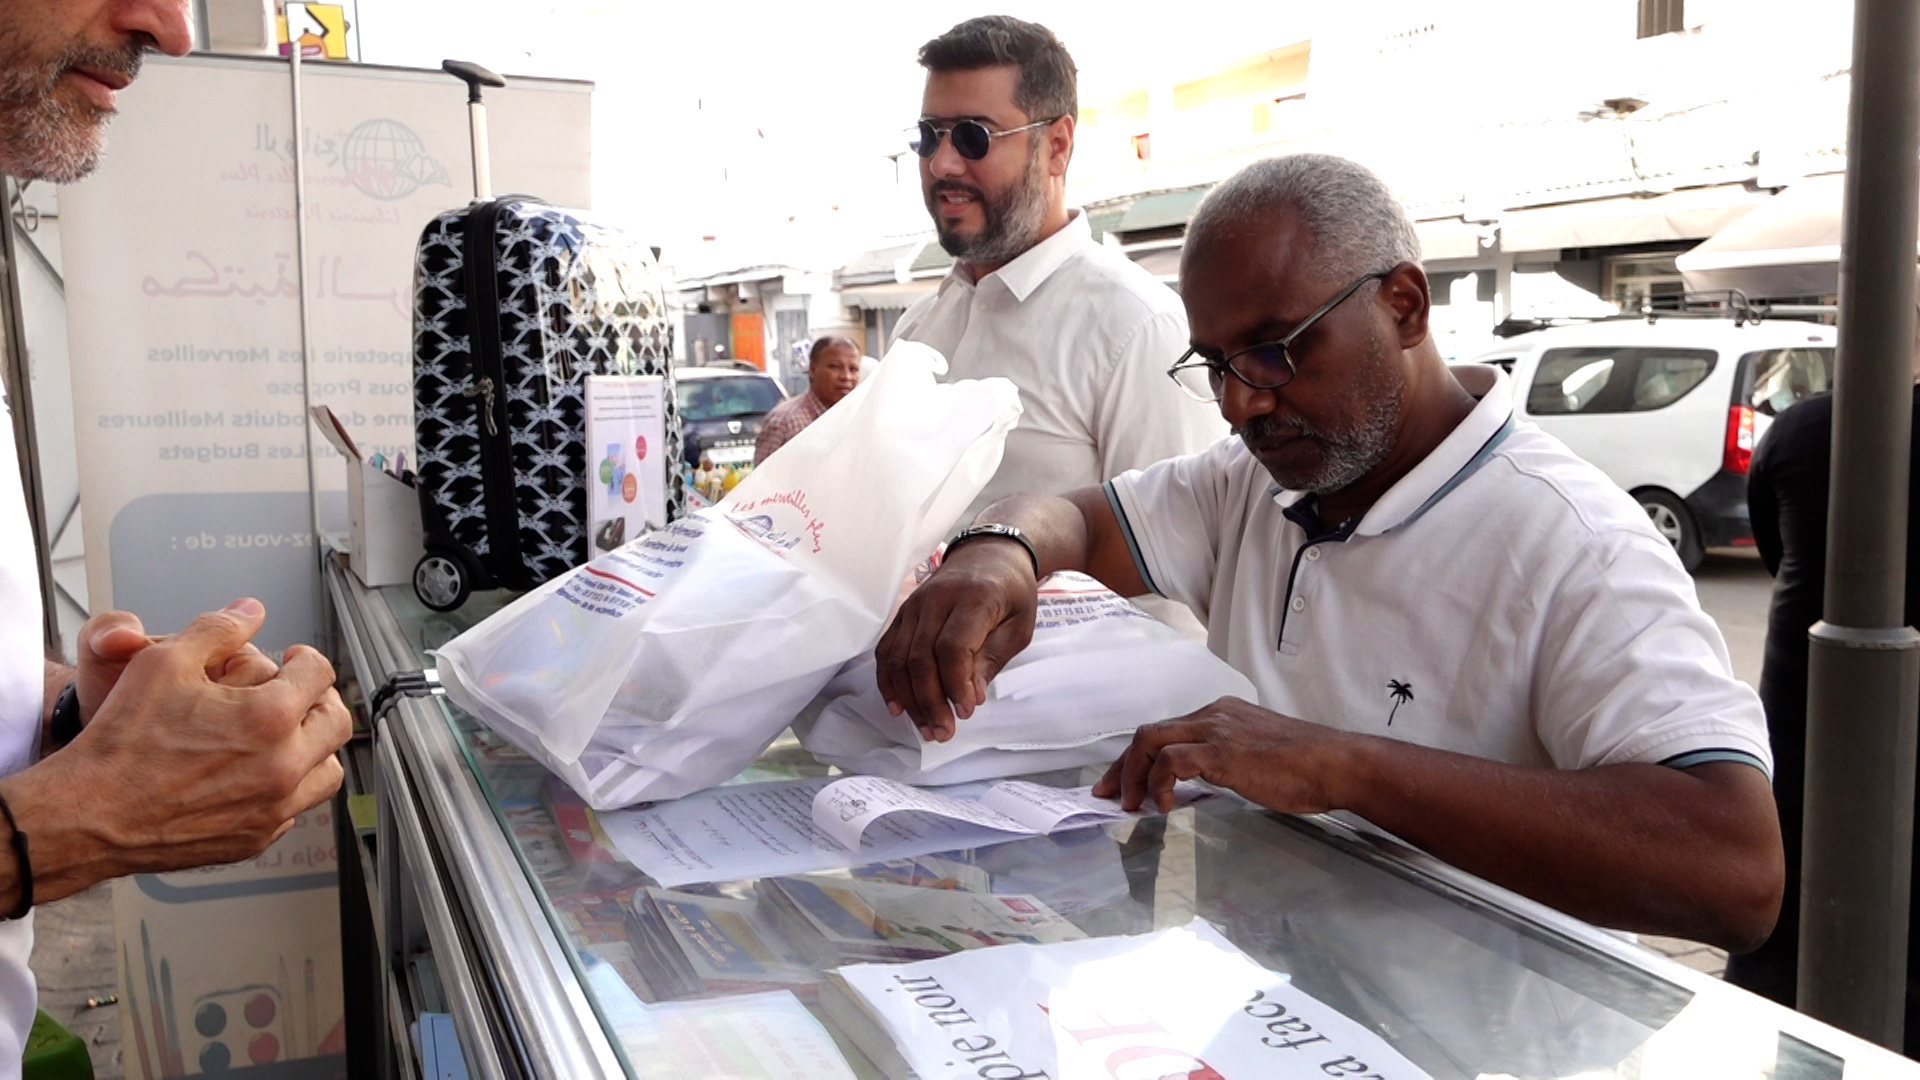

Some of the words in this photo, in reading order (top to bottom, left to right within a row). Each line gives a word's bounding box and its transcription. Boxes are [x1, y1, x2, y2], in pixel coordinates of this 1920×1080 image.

[884, 974, 977, 1028] noir
[944, 1034, 1050, 1080] pie
[1319, 1055, 1386, 1080] a
